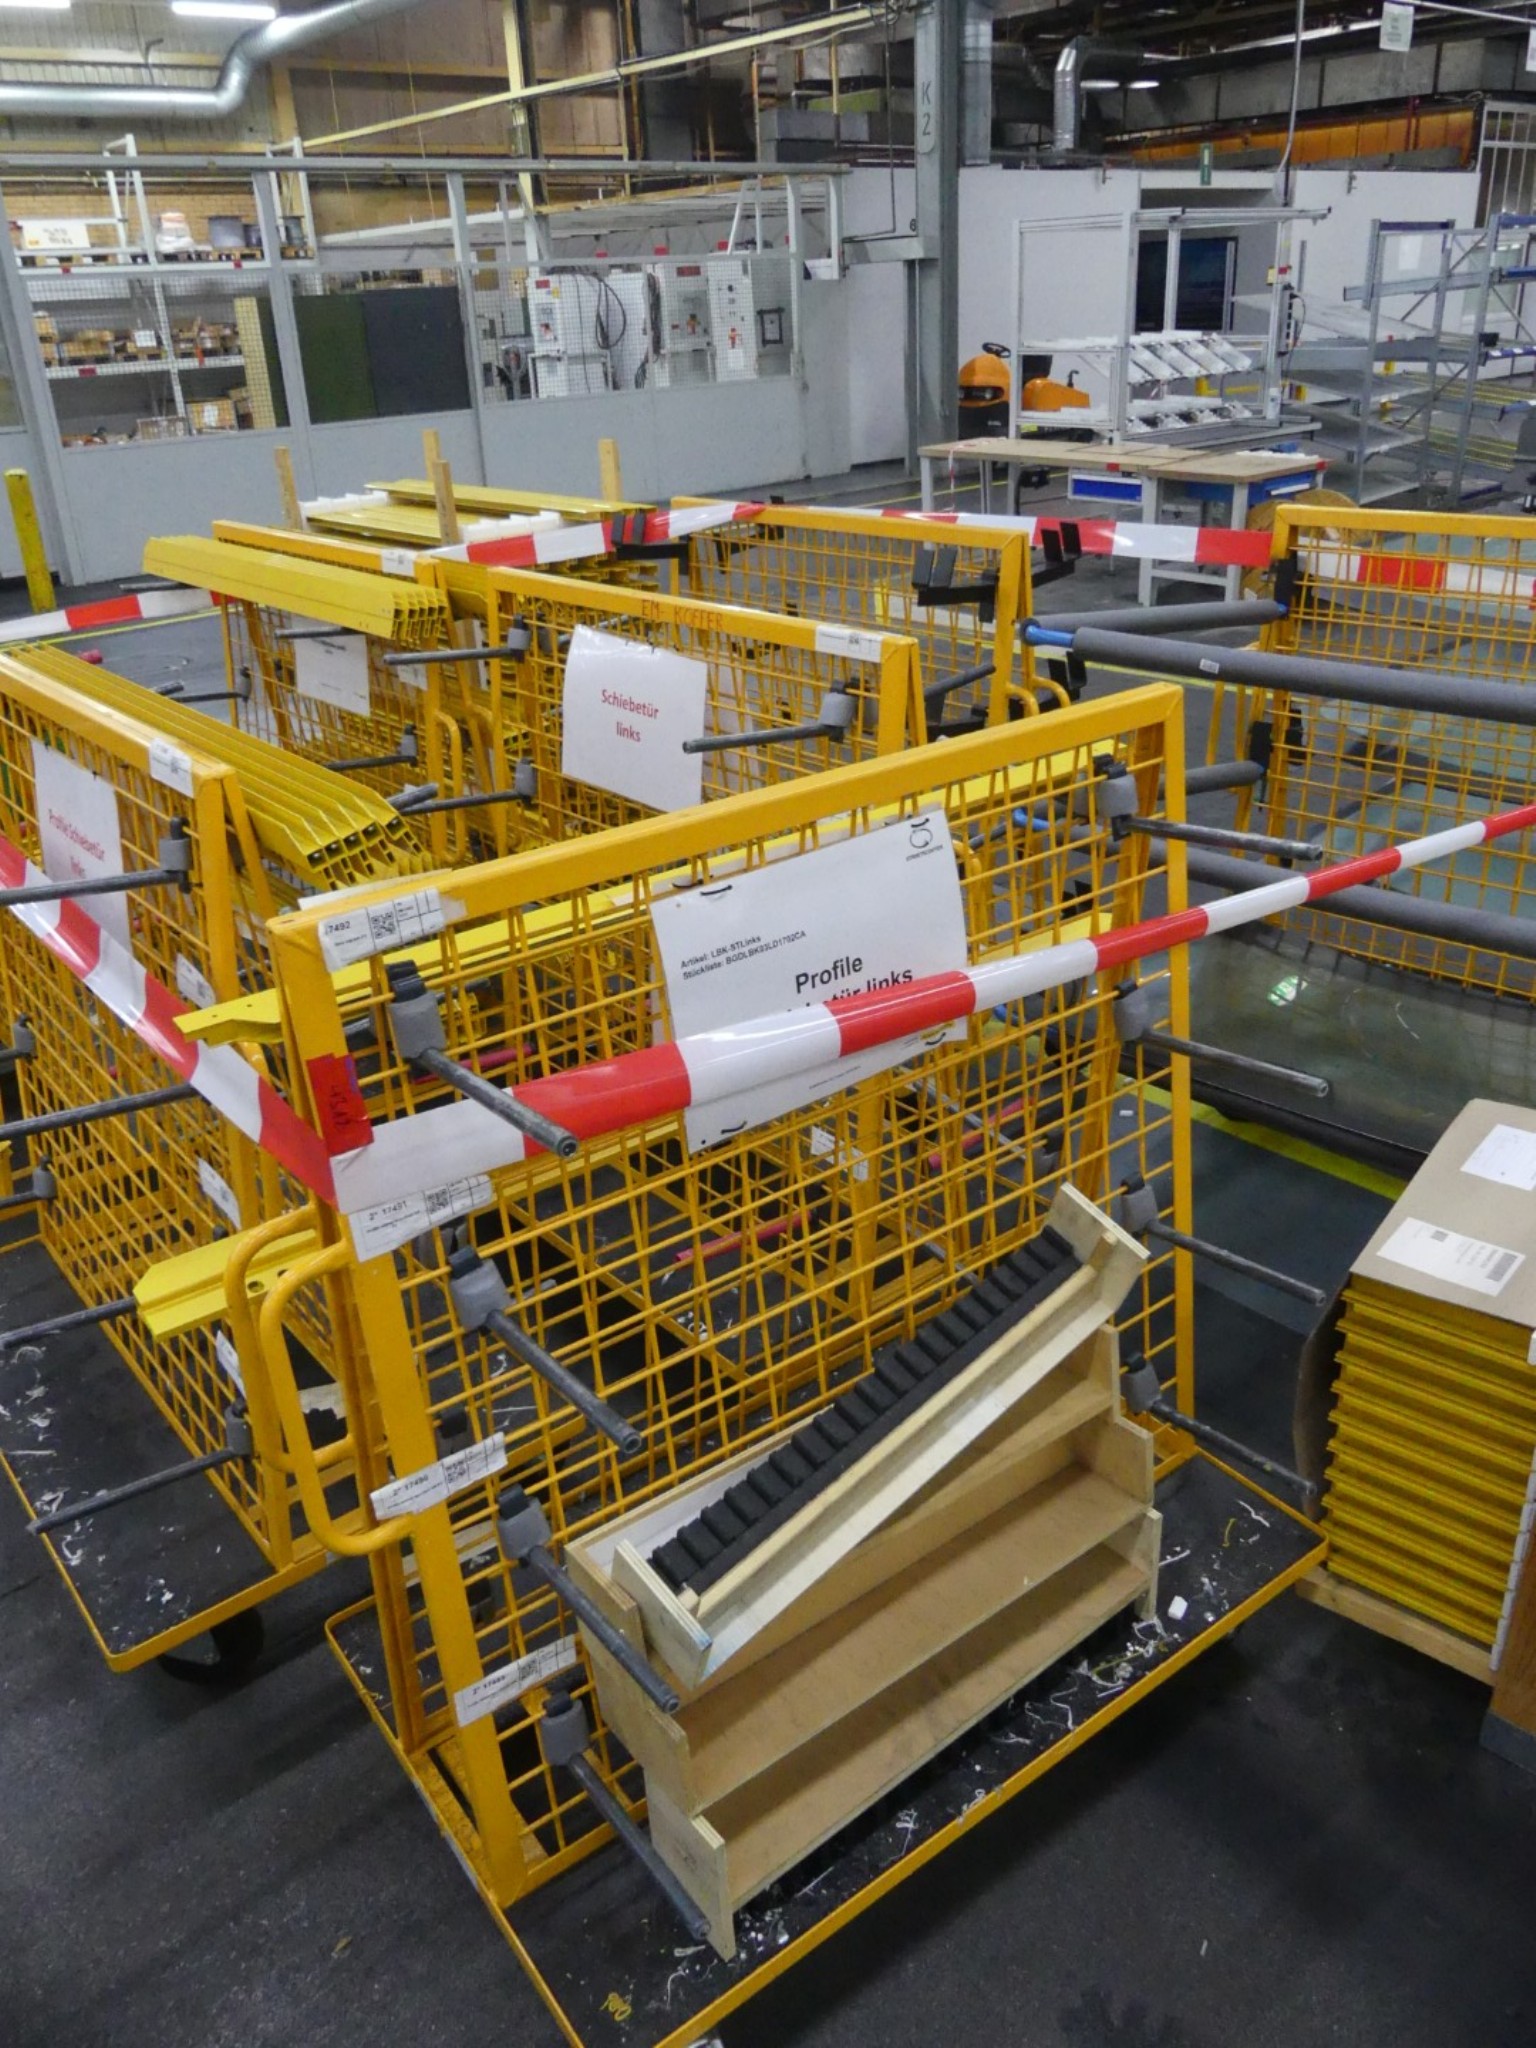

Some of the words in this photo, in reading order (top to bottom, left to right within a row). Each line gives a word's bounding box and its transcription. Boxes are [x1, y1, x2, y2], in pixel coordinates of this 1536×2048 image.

[602, 688, 660, 720] Schiebetür
[616, 721, 642, 743] links
[795, 956, 863, 994] Profile
